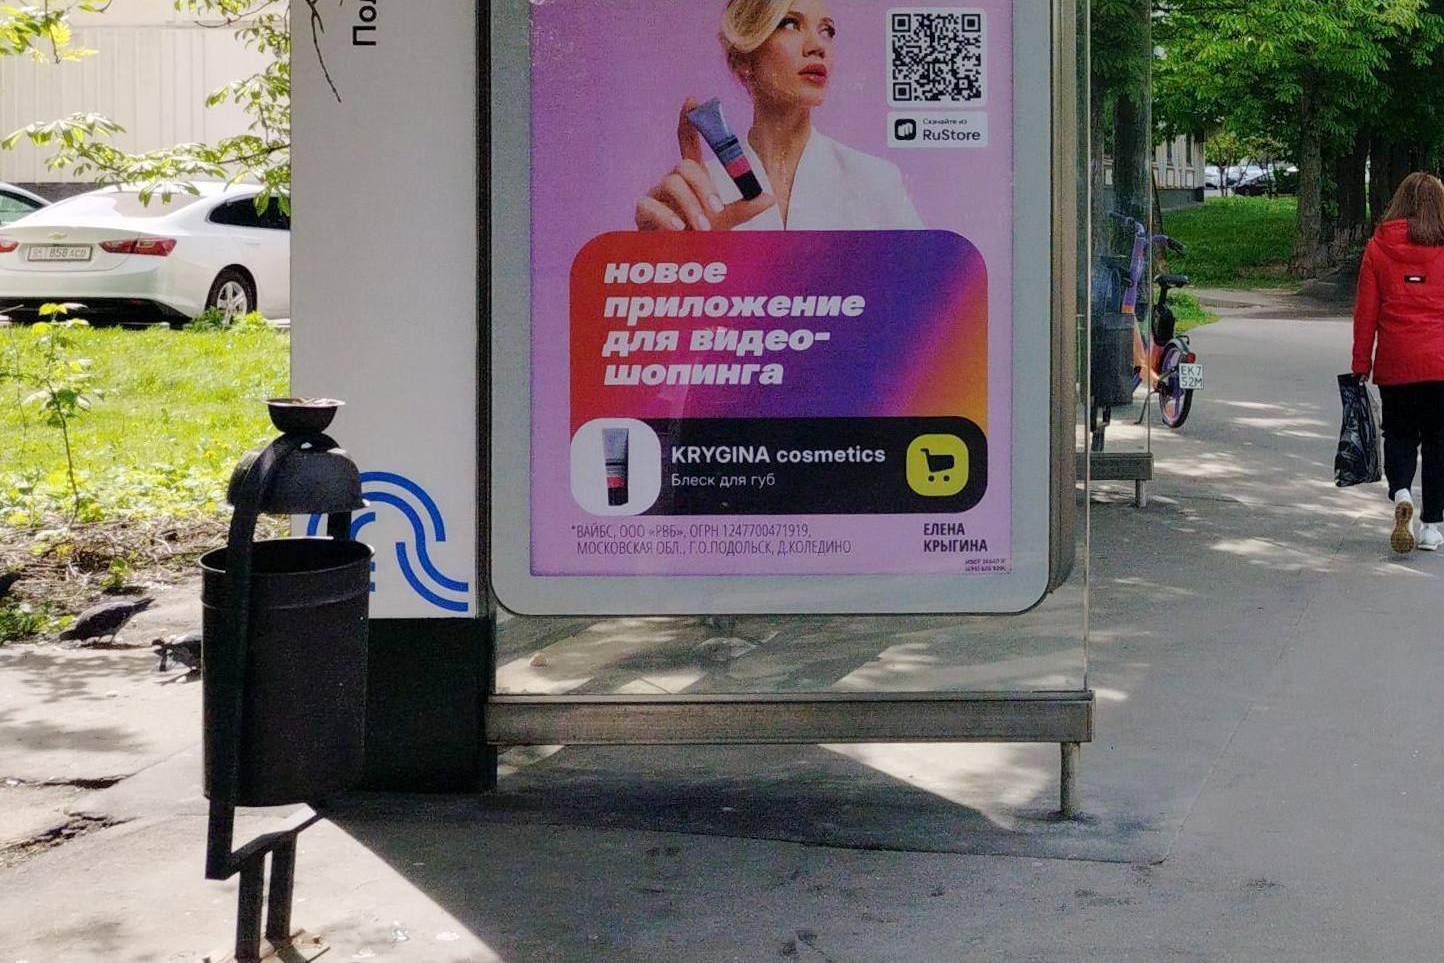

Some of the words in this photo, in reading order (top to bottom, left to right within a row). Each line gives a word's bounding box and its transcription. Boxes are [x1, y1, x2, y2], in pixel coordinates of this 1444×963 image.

[922, 129, 981, 141] RuStore
[603, 261, 727, 284] новое
[603, 294, 866, 326] приложение
[601, 329, 678, 357] для
[689, 327, 831, 357] видео-
[603, 363, 784, 386] шопинга
[671, 446, 769, 463] KRYGINA
[776, 446, 886, 463] cosmetics
[671, 472, 715, 487] Блеск
[720, 474, 746, 488] для
[751, 472, 776, 490] губ
[619, 525, 645, 537] ООО
[690, 524, 719, 537] ОГРН
[723, 524, 811, 538] 1247700471919,
[924, 523, 965, 536] ЕЛЕНА
[577, 541, 652, 555] МОСКОВСКАЯ
[924, 539, 988, 553] КРЫГИНА
